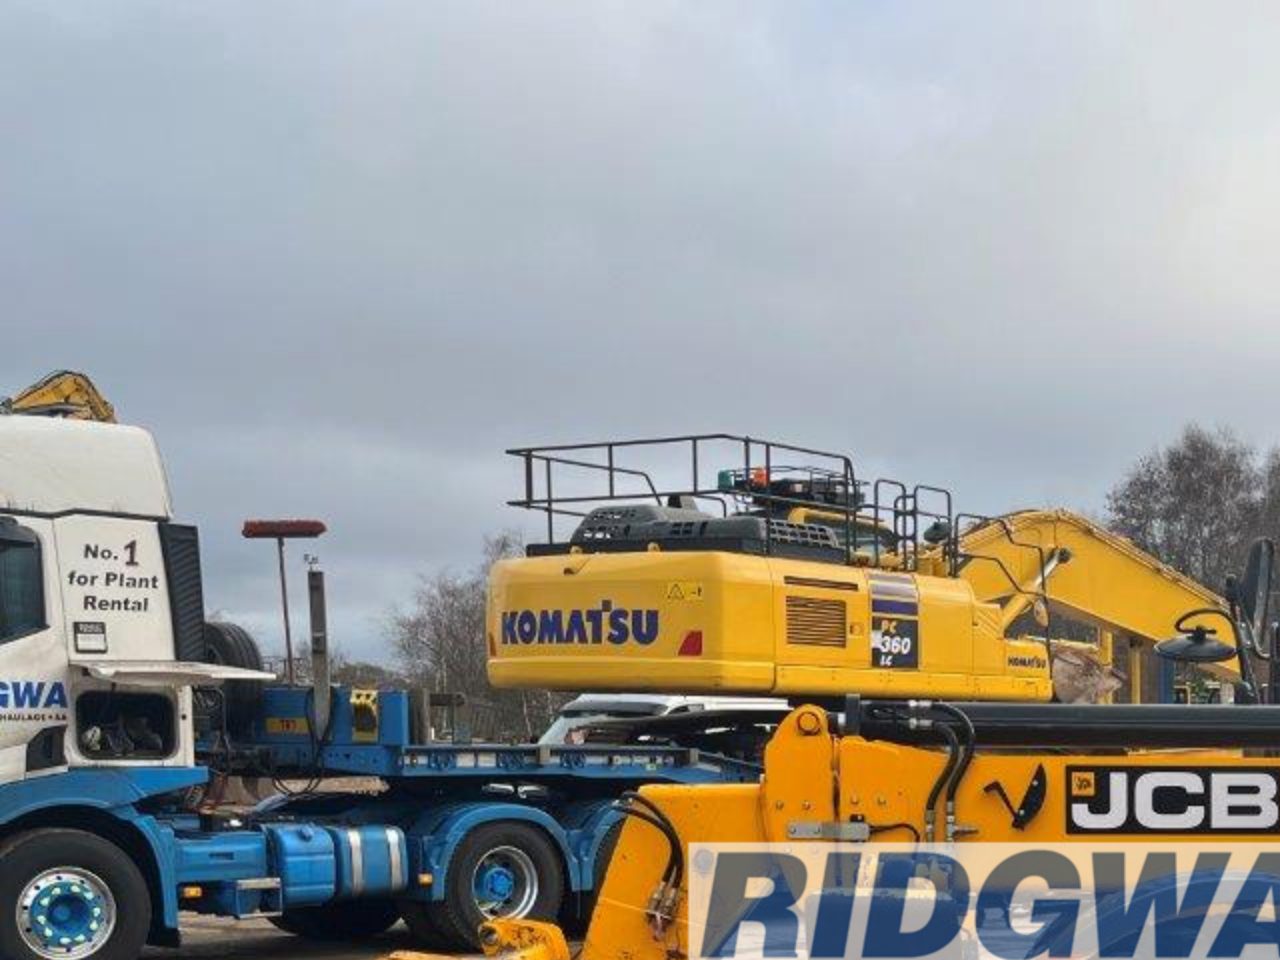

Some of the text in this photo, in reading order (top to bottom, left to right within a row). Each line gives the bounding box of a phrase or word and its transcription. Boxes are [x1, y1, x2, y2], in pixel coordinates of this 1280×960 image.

[84, 539, 139, 566] No. 1
[67, 570, 159, 589] for Plant
[83, 595, 149, 612] Rental
[501, 599, 660, 645] KOMATSU
[880, 619, 897, 634] PC
[880, 635, 912, 655] 360
[1007, 655, 1047, 669] KOMATSU
[1071, 771, 1280, 830] JCB
